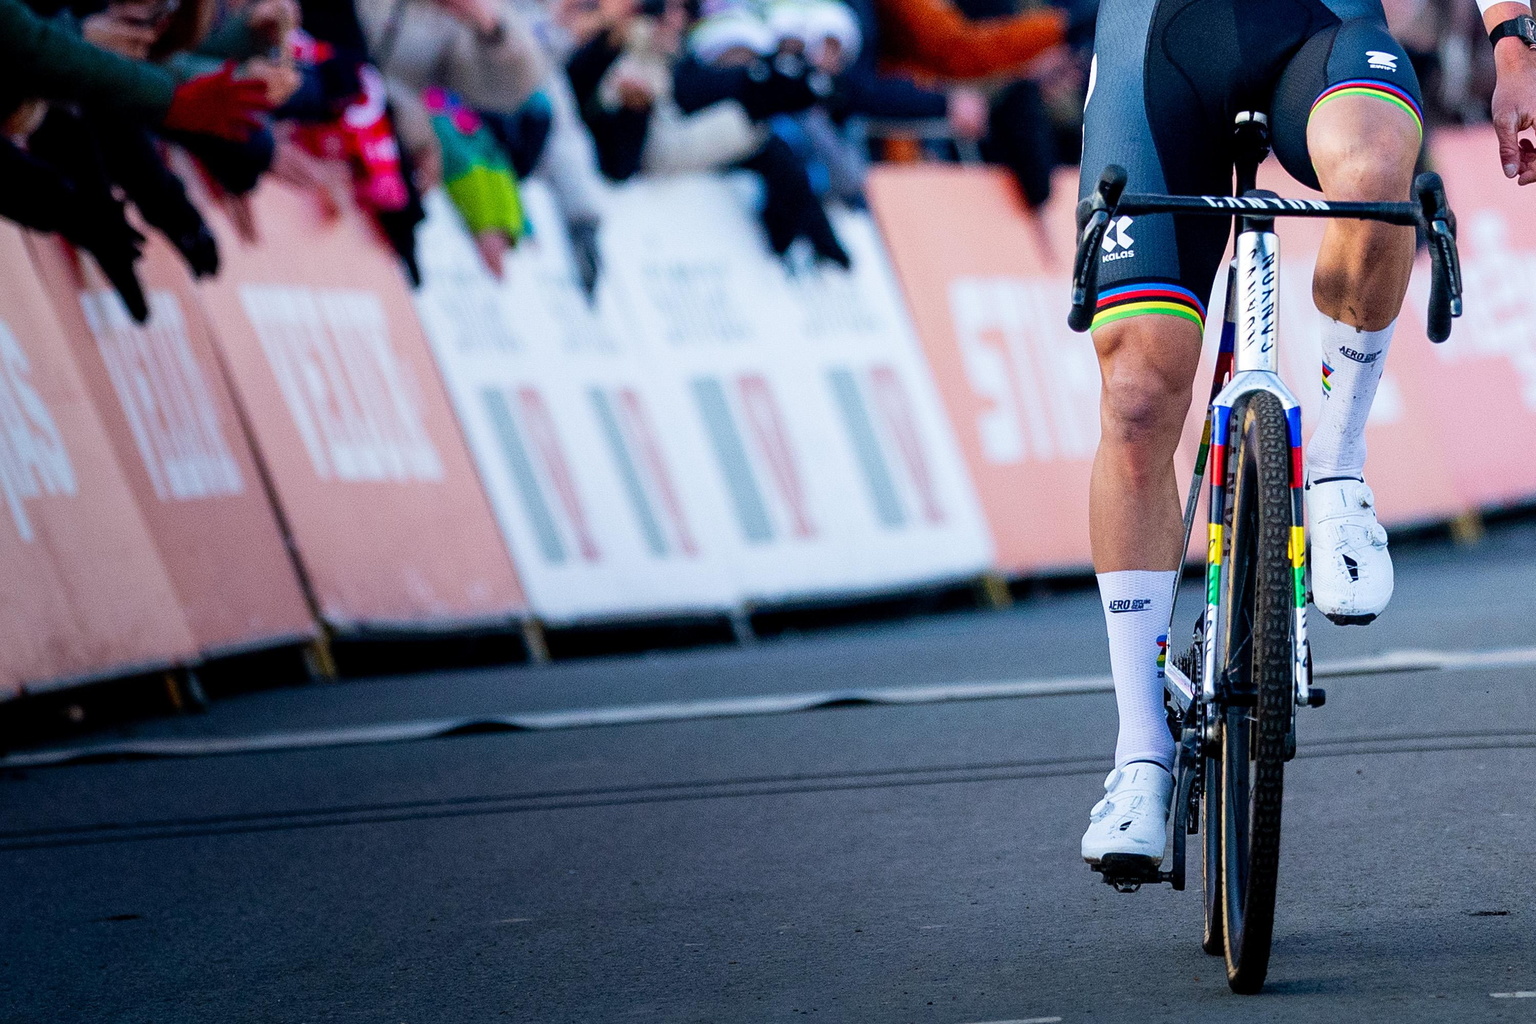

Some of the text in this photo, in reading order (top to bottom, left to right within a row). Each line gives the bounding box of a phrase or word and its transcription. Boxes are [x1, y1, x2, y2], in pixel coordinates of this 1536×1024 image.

[1200, 195, 1330, 210] CANYON
[1261, 251, 1275, 353] CANYON
[1339, 345, 1365, 361] AERO
[1109, 599, 1131, 610] AERO
